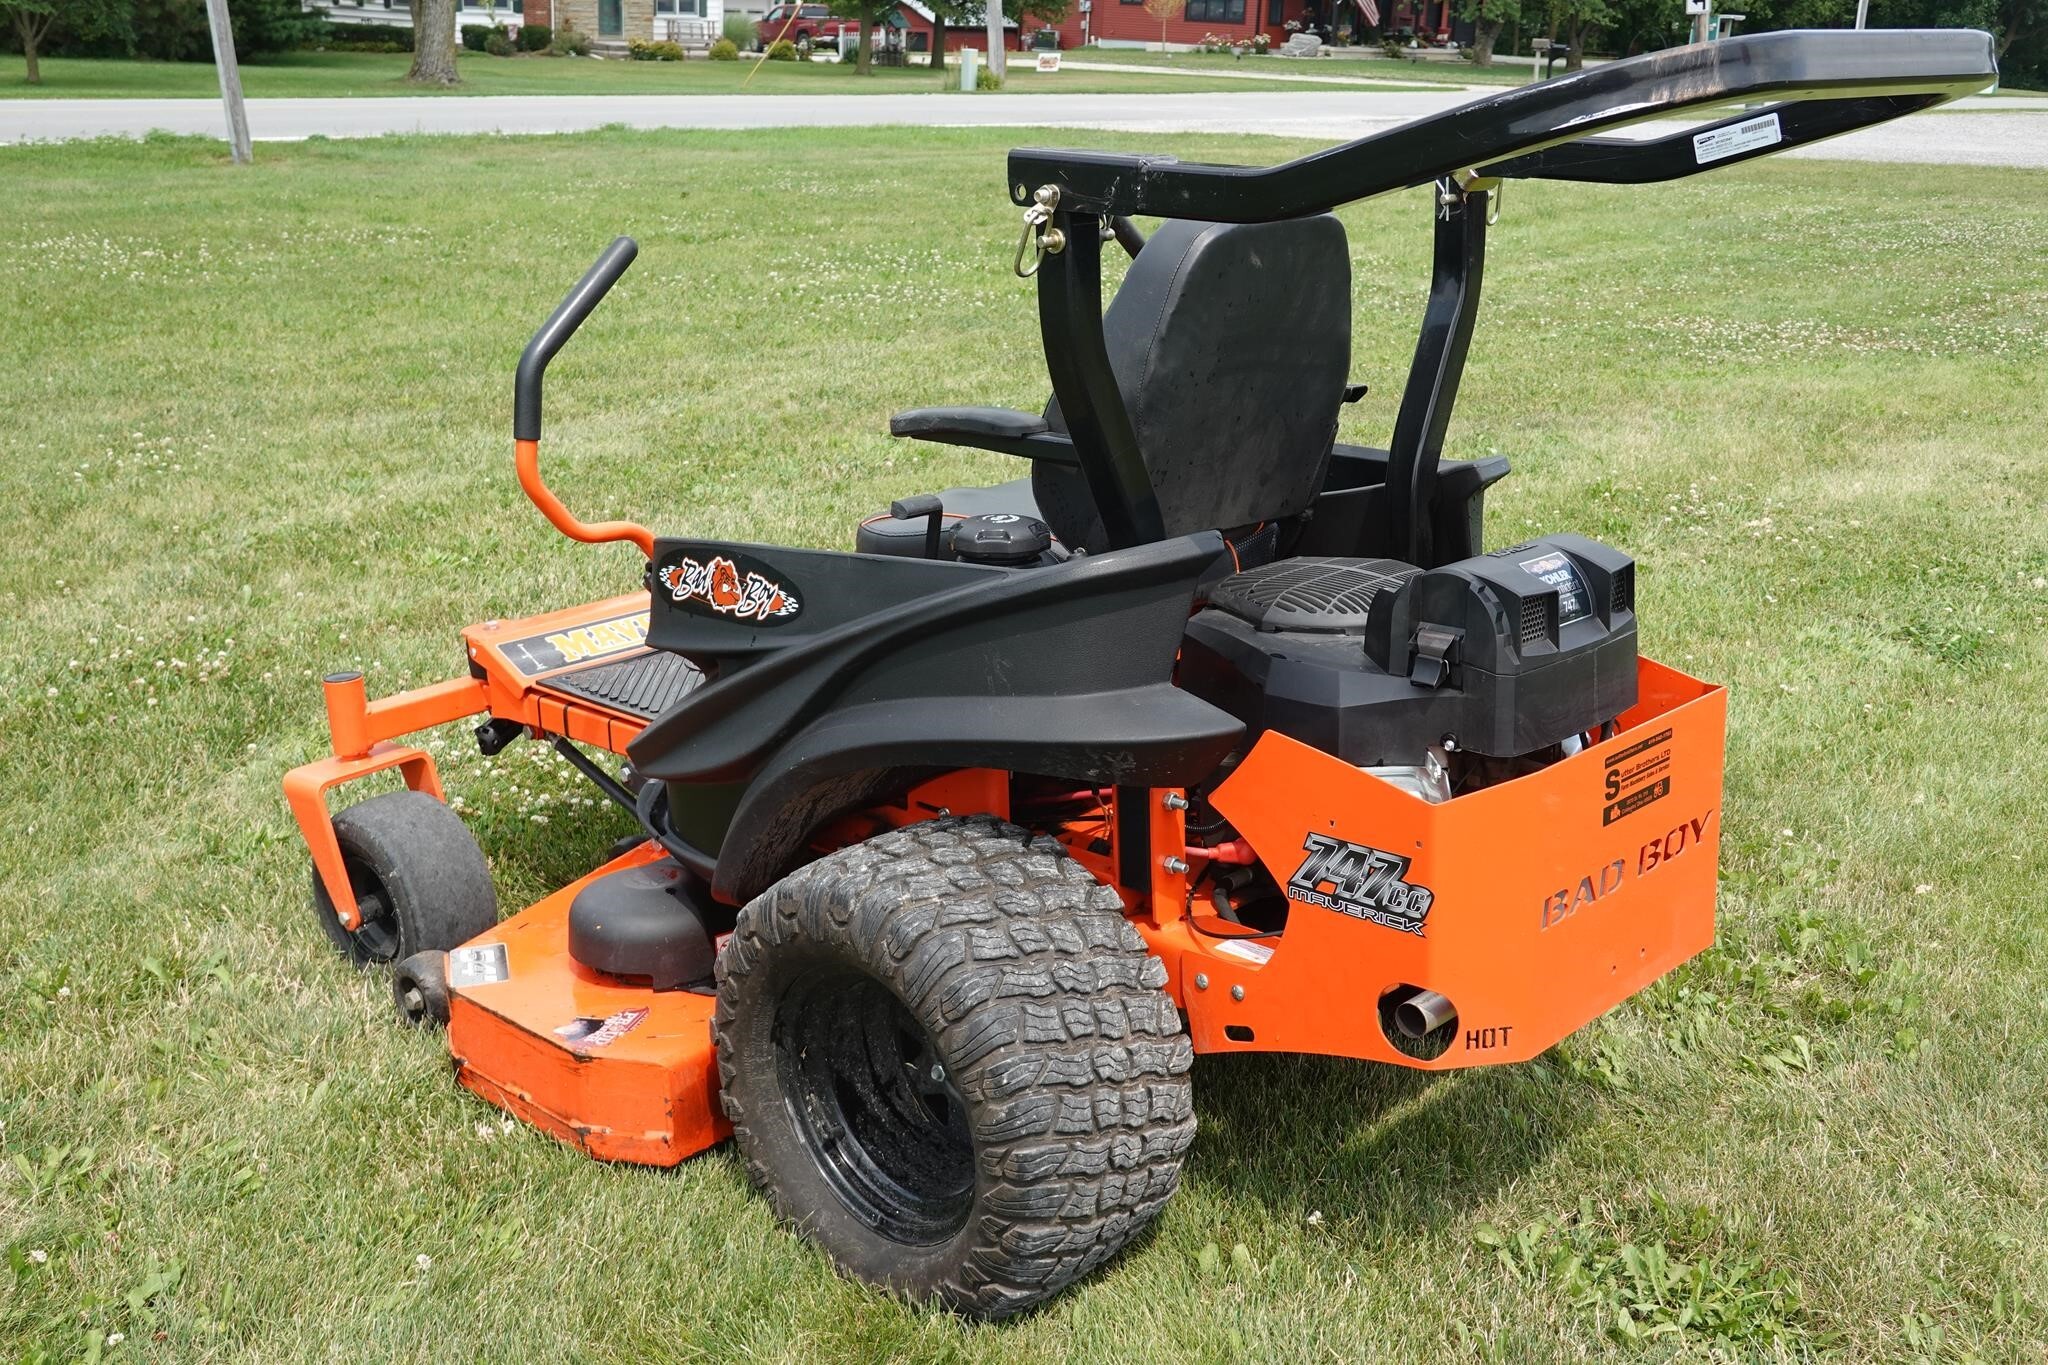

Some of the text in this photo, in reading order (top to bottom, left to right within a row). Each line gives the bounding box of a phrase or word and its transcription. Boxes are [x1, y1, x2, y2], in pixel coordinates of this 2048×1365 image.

[673, 558, 778, 619] Bad Boy
[1562, 598, 1577, 613] 747
[1541, 809, 1714, 932] BAD BOY
[1288, 885, 1426, 938] MAVERICK
[1465, 1026, 1513, 1050] HOT
